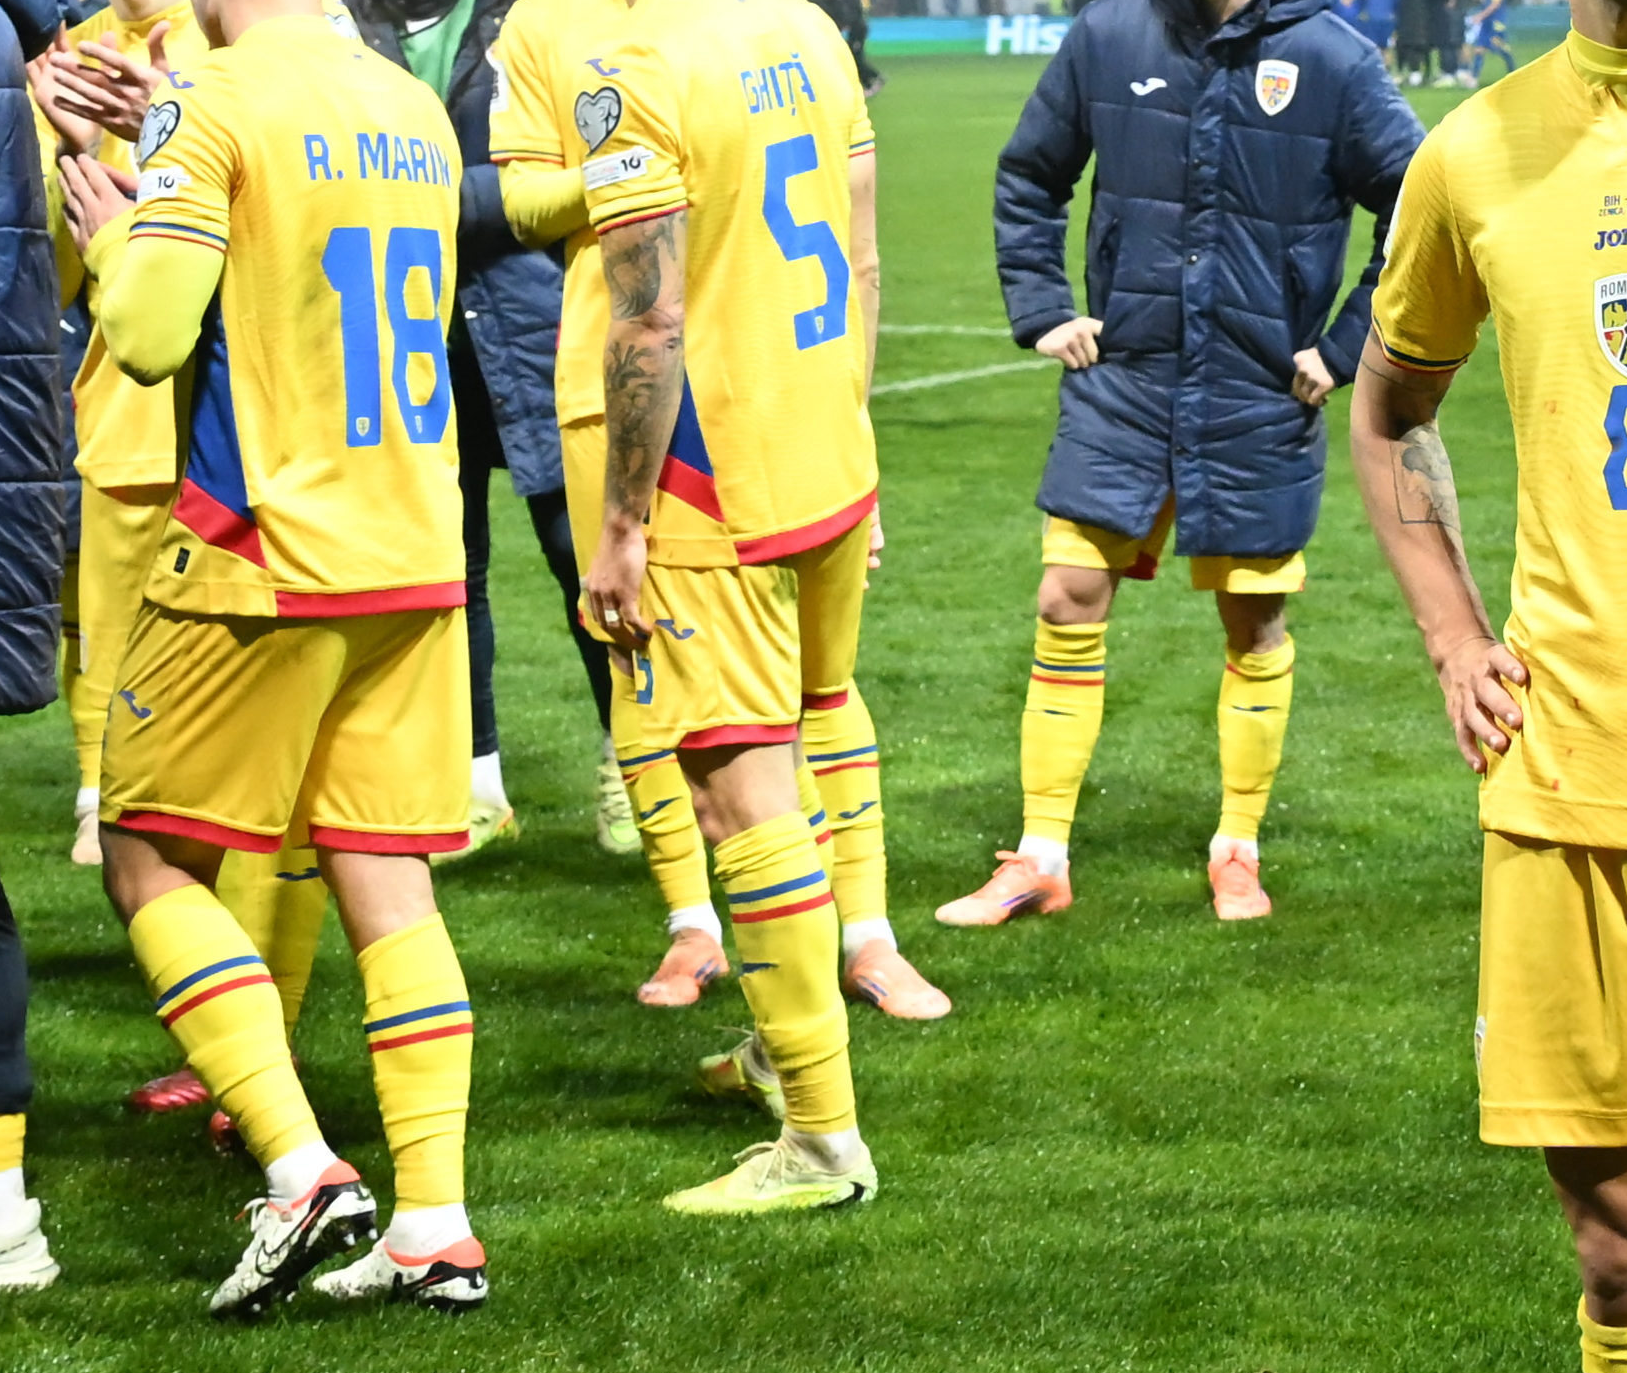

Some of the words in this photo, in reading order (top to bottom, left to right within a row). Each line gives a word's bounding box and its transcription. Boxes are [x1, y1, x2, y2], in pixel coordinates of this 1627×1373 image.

[985, 14, 1069, 56] His
[304, 133, 344, 181] R.
[356, 132, 452, 189] MARIN
[761, 133, 850, 350] 5
[321, 226, 451, 448] 18
